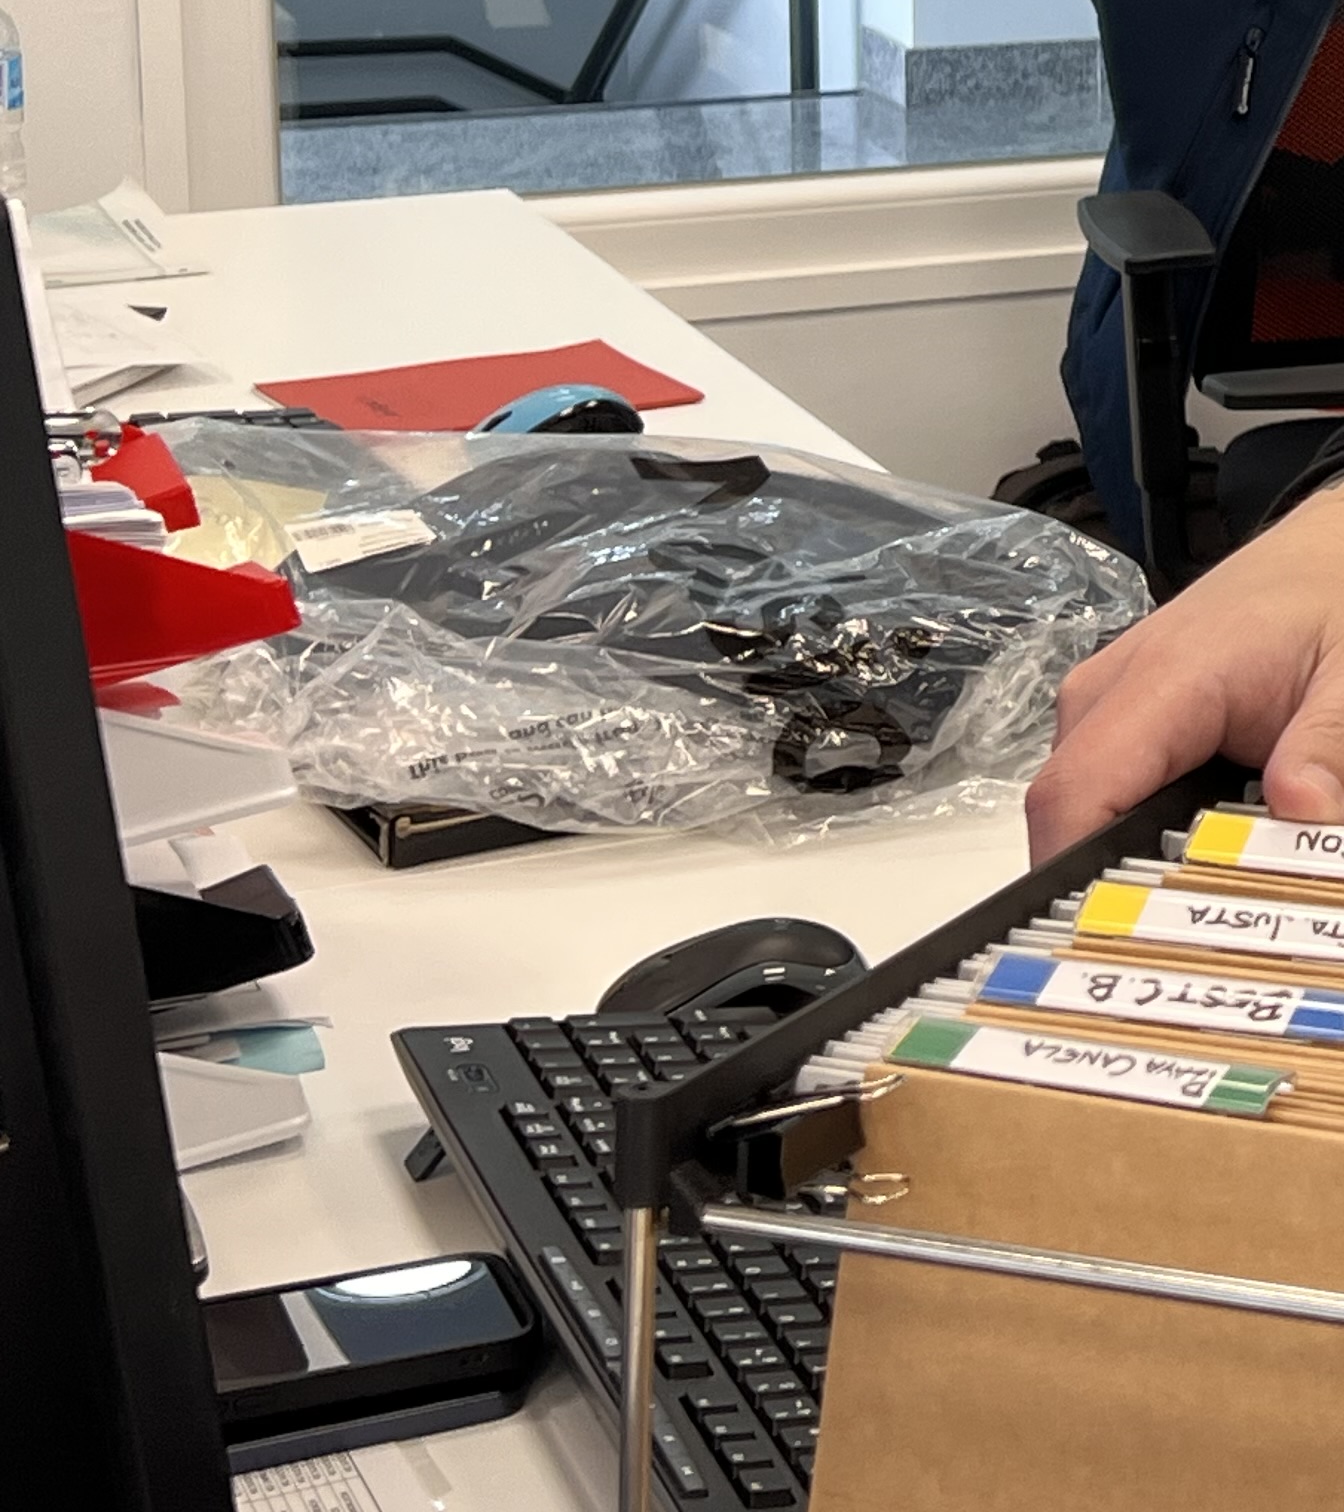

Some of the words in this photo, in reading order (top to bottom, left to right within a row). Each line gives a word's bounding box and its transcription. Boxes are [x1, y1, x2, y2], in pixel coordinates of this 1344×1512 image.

[1187, 905, 1290, 941] JUSTA
[1021, 1039, 1138, 1078] CANELA
[1146, 1058, 1219, 1099] PLAYA
